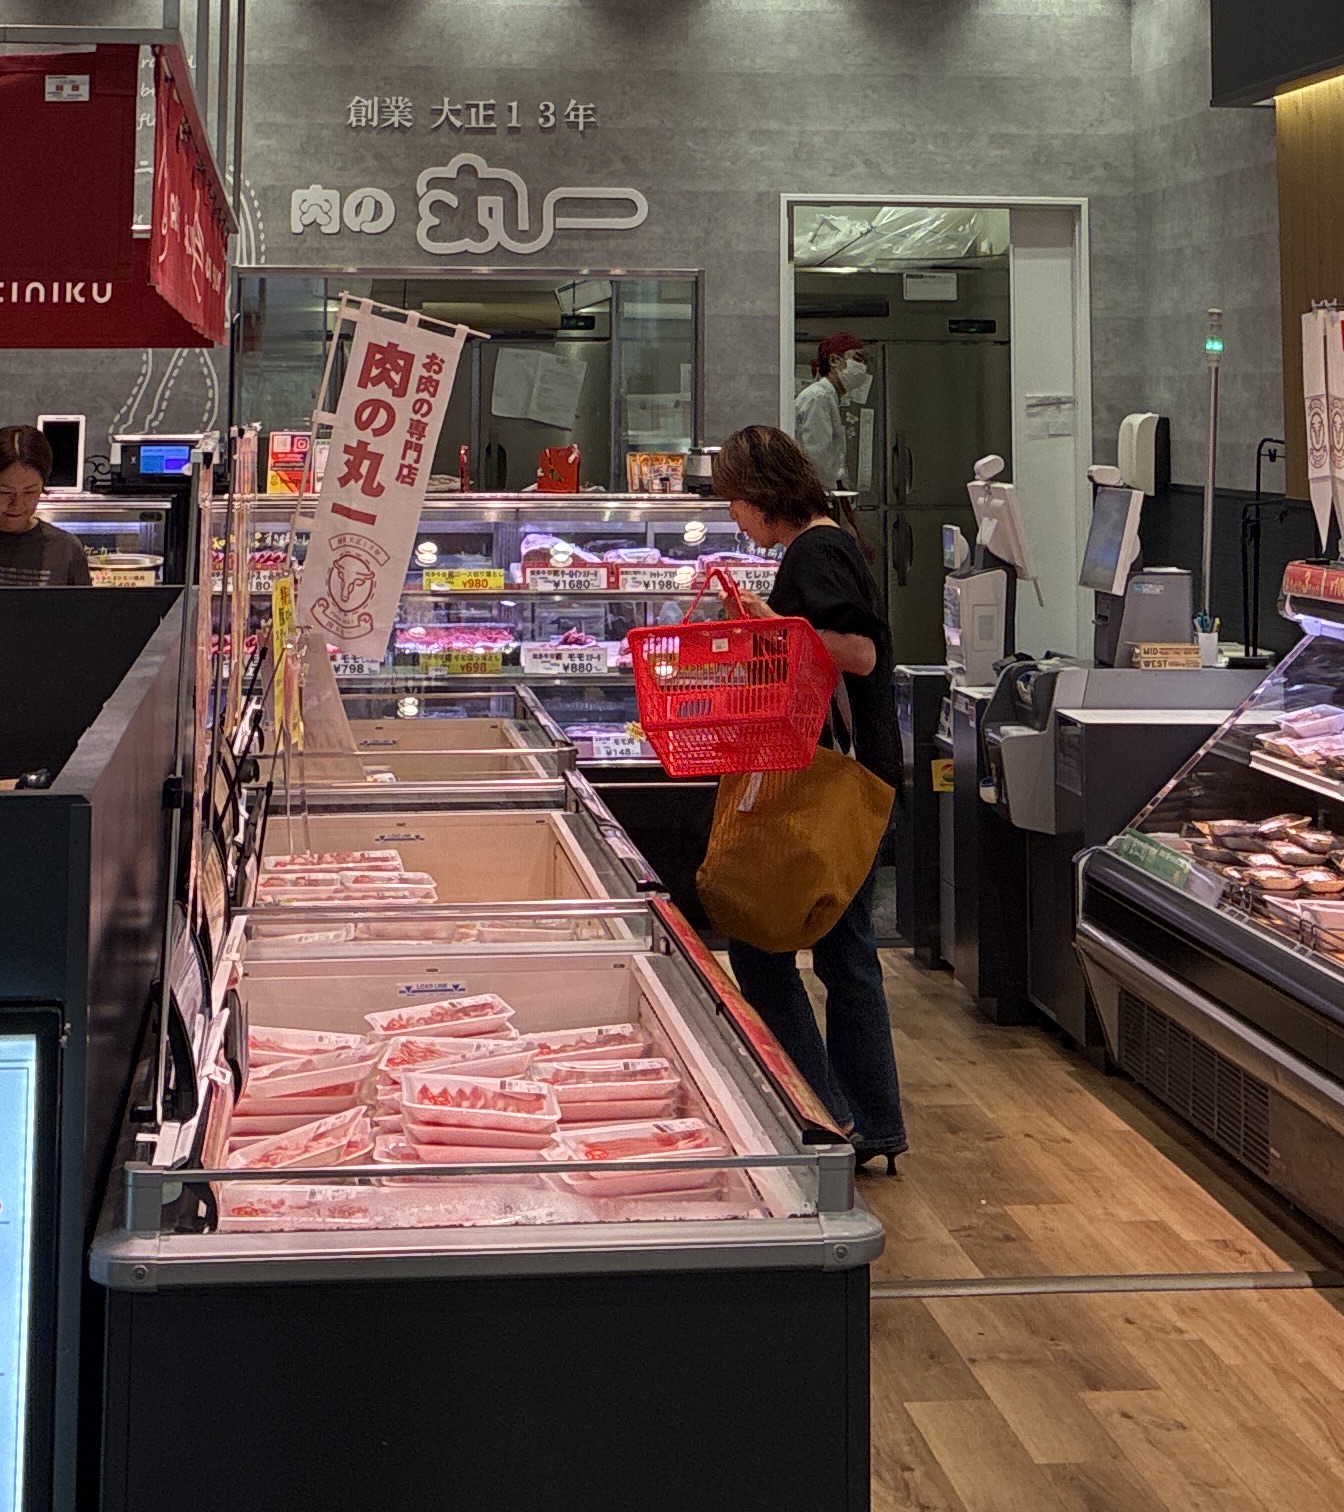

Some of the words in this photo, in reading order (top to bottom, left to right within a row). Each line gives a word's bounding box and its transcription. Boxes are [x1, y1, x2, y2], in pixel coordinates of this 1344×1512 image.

[346, 96, 413, 129] 創業
[396, 352, 446, 487] お肉の専門店
[330, 341, 416, 526] 肉の丸一
[462, 579, 488, 588] ¥980
[553, 579, 590, 590] ¥1680
[333, 664, 364, 674] ¥798
[562, 663, 593, 673] ¥880
